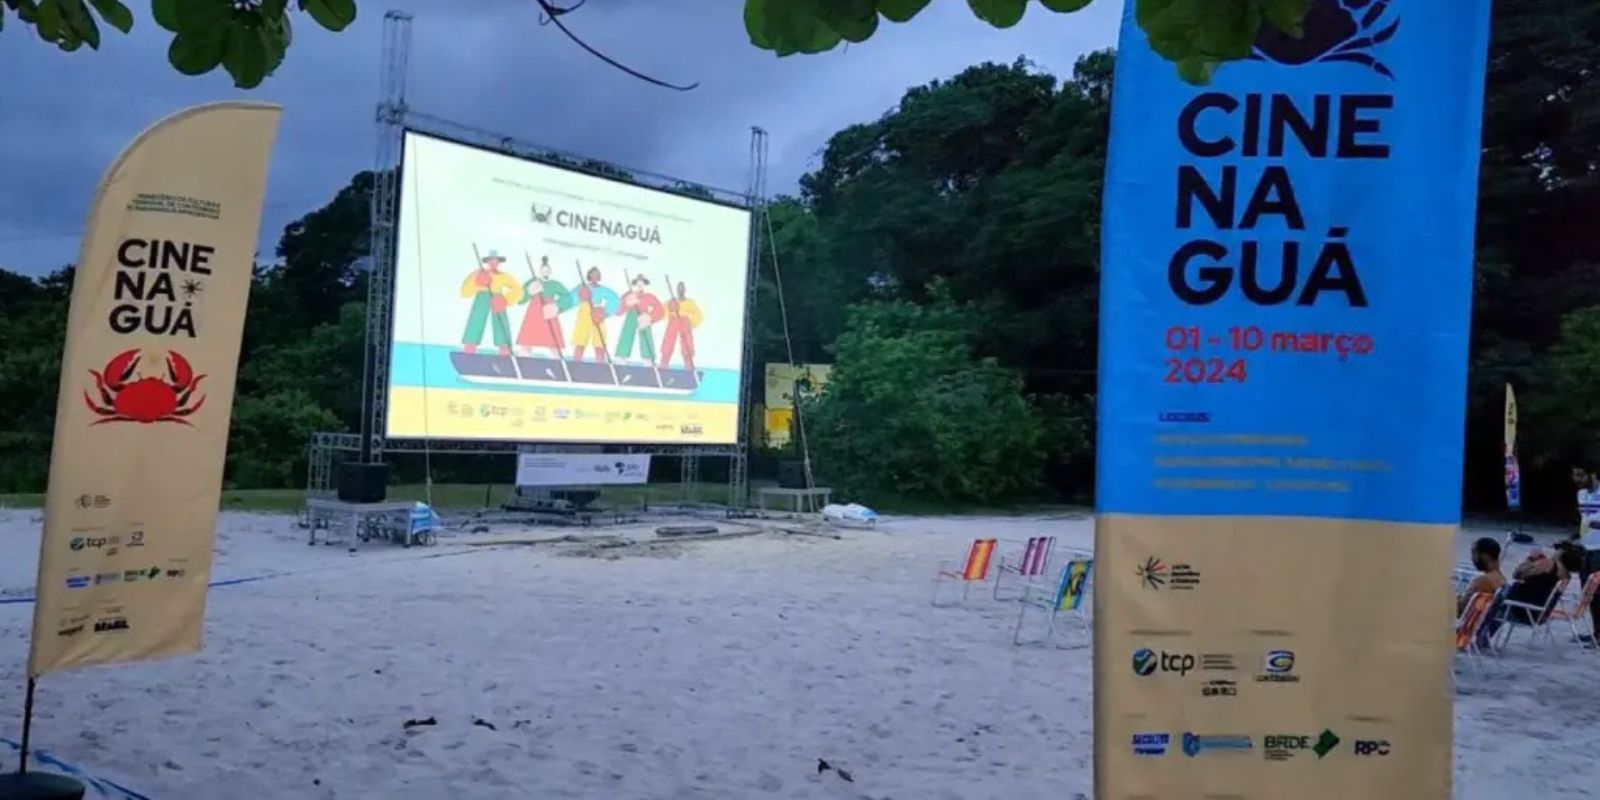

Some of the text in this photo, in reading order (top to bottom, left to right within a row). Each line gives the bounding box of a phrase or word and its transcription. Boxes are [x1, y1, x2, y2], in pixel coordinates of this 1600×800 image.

[1177, 92, 1394, 159] CINE
[1175, 165, 1306, 230] NA
[555, 208, 662, 246] CINENAGUÁ
[117, 238, 215, 277] CINE
[1167, 226, 1369, 308] GUÁ
[114, 271, 176, 302] NA
[108, 300, 197, 338] GUÁ
[1164, 325, 1201, 352] 01
[1229, 326, 1264, 352] 10
[1270, 331, 1374, 361] março
[1164, 357, 1247, 384] 2024
[86, 536, 107, 550] tcp
[1161, 650, 1195, 676] tcp
